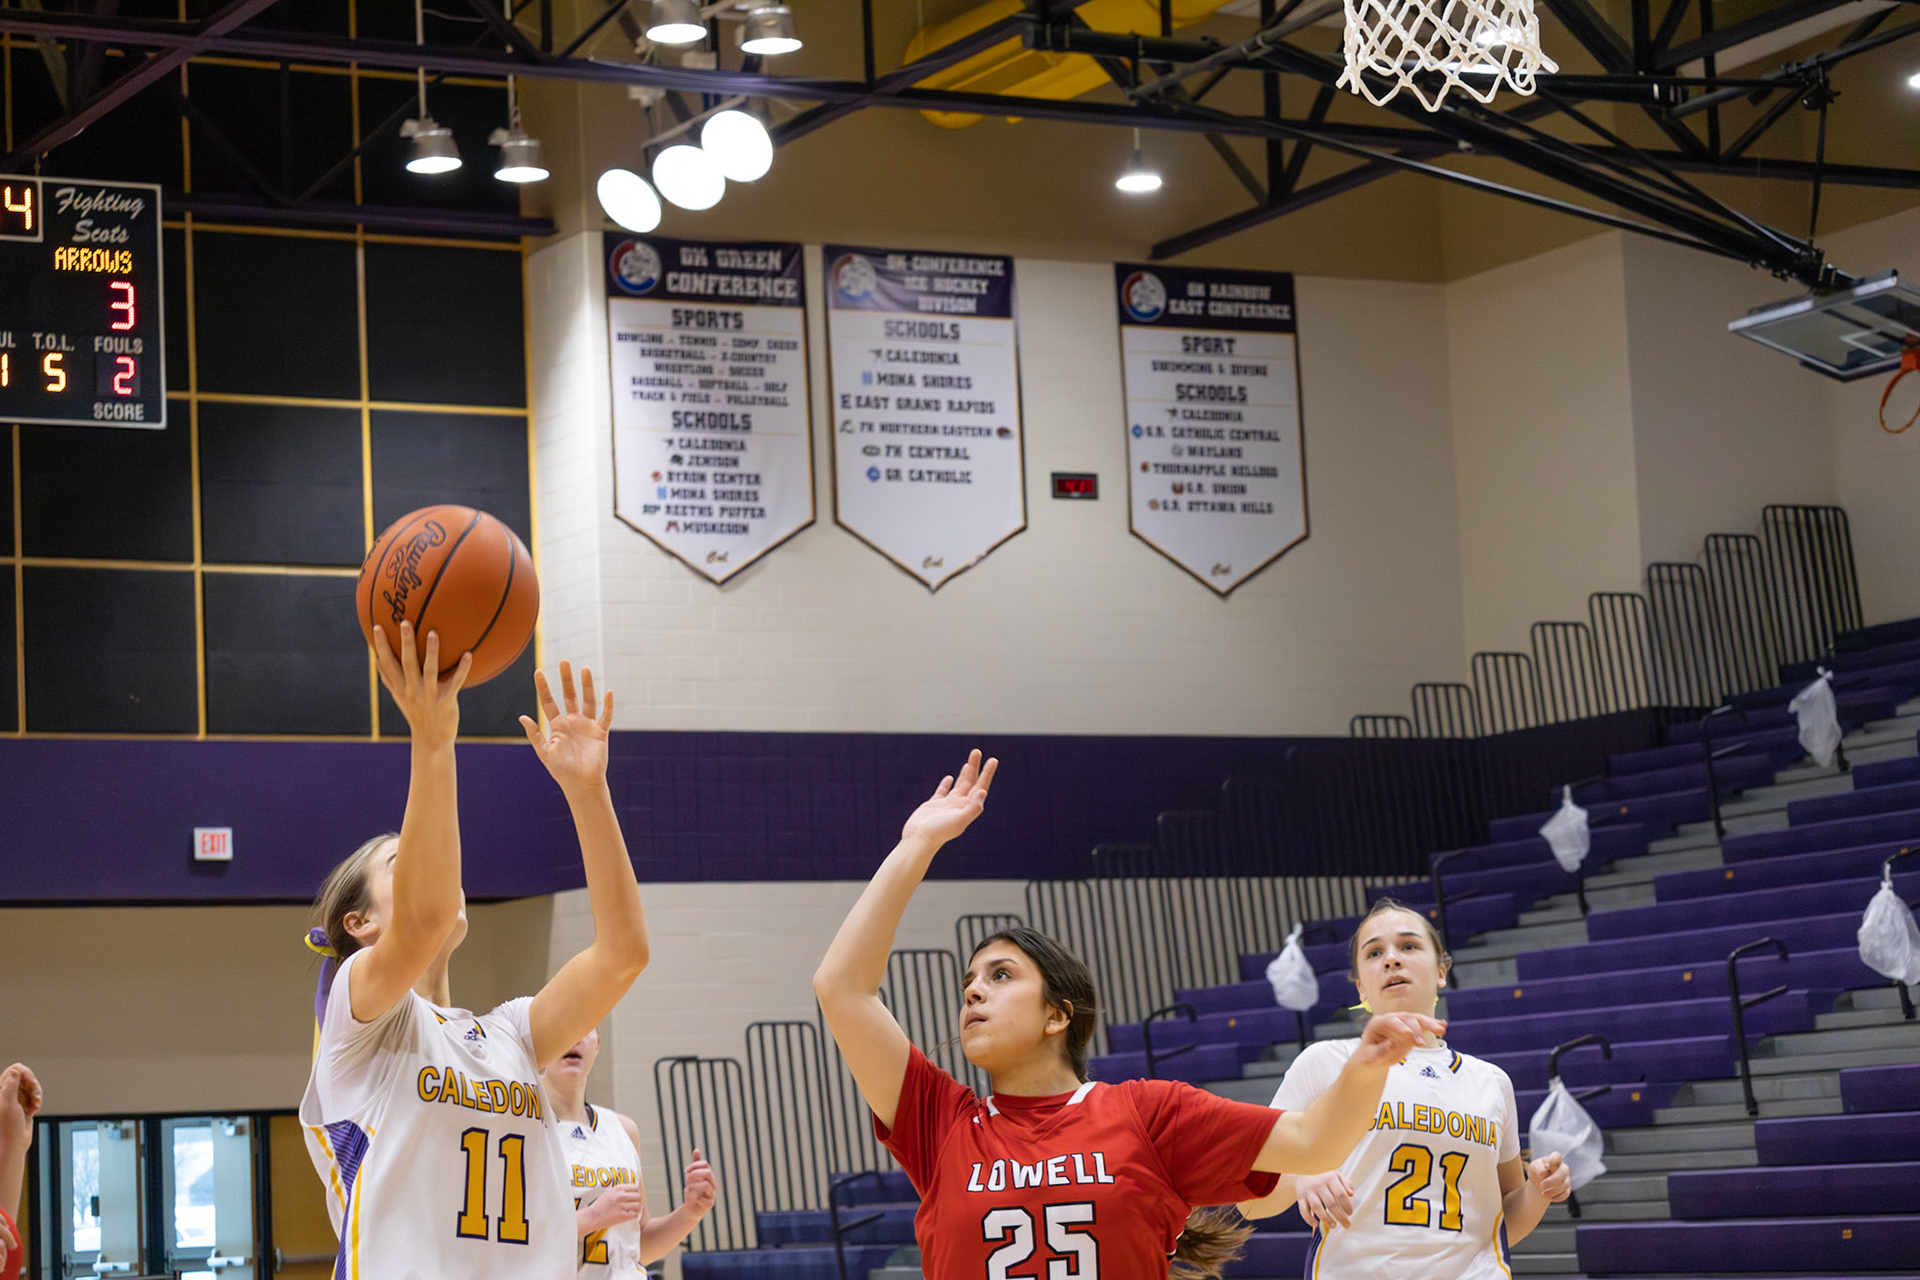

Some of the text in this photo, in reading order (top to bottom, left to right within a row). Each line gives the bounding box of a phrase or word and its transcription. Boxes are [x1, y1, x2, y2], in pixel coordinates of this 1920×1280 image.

[4, 186, 32, 230] 4
[55, 186, 145, 220] Fighting
[71, 218, 130, 244] Scots
[54, 246, 133, 274] ARROWS
[680, 247, 782, 273] OK GREEN
[912, 256, 1005, 276] CONFERENCE
[666, 272, 797, 299] CONFERENCE
[933, 278, 989, 295] HOCKEY
[1209, 284, 1271, 300] RAINBOW
[110, 281, 135, 330] 3
[1169, 299, 1291, 319] EAST CONFERENCE
[672, 309, 744, 330] SPORTS
[884, 319, 960, 340] SCHOOLS
[94, 336, 143, 354] FOULS
[617, 333, 663, 344] BOWLING
[679, 335, 717, 347] TENNIS
[1181, 336, 1236, 354] SPORT
[640, 348, 706, 360] BASKETBALL
[887, 349, 960, 365] CALEDONIA
[43, 352, 67, 392] 5
[113, 356, 135, 395] 2
[655, 363, 765, 377] WRESTLING SOCCER
[1152, 360, 1212, 374] SWIMMING
[632, 377, 683, 389] BASEBALL
[699, 379, 748, 392] SOFTBALL
[877, 372, 972, 389] MONA SHORES
[632, 390, 665, 401] TRACK
[681, 392, 711, 404] FIELD
[727, 395, 789, 408] VOLLEYBALL
[1176, 383, 1247, 402] SCHOOLS
[93, 402, 144, 420] SCORE
[855, 395, 889, 410] EAST
[897, 397, 941, 412] GRAND
[947, 400, 995, 415] RAPIDS
[672, 410, 752, 431] SCHOOLS
[1182, 409, 1244, 422] CALEDONIA
[879, 422, 939, 435] NORTHERN
[942, 424, 992, 437] EASTERN
[1171, 426, 1224, 440] CATHOLIC
[1229, 428, 1280, 442] CENTRAL
[678, 438, 746, 451] CALEDONIA
[908, 446, 970, 460] CENTRAL
[713, 472, 762, 485] CENTER
[909, 470, 972, 484] CATHOLIC
[671, 488, 759, 502] MONA SHORES
[383, 520, 447, 626] Rawlings
[202, 832, 226, 854] EXIT
[418, 1066, 544, 1124] CALEDON
[570, 1164, 637, 1187] EDONI
[966, 1152, 1115, 1192] LOWELL
[456, 1127, 529, 1245] 11
[1384, 1143, 1469, 1232] 21
[981, 1201, 1099, 1280] 25
